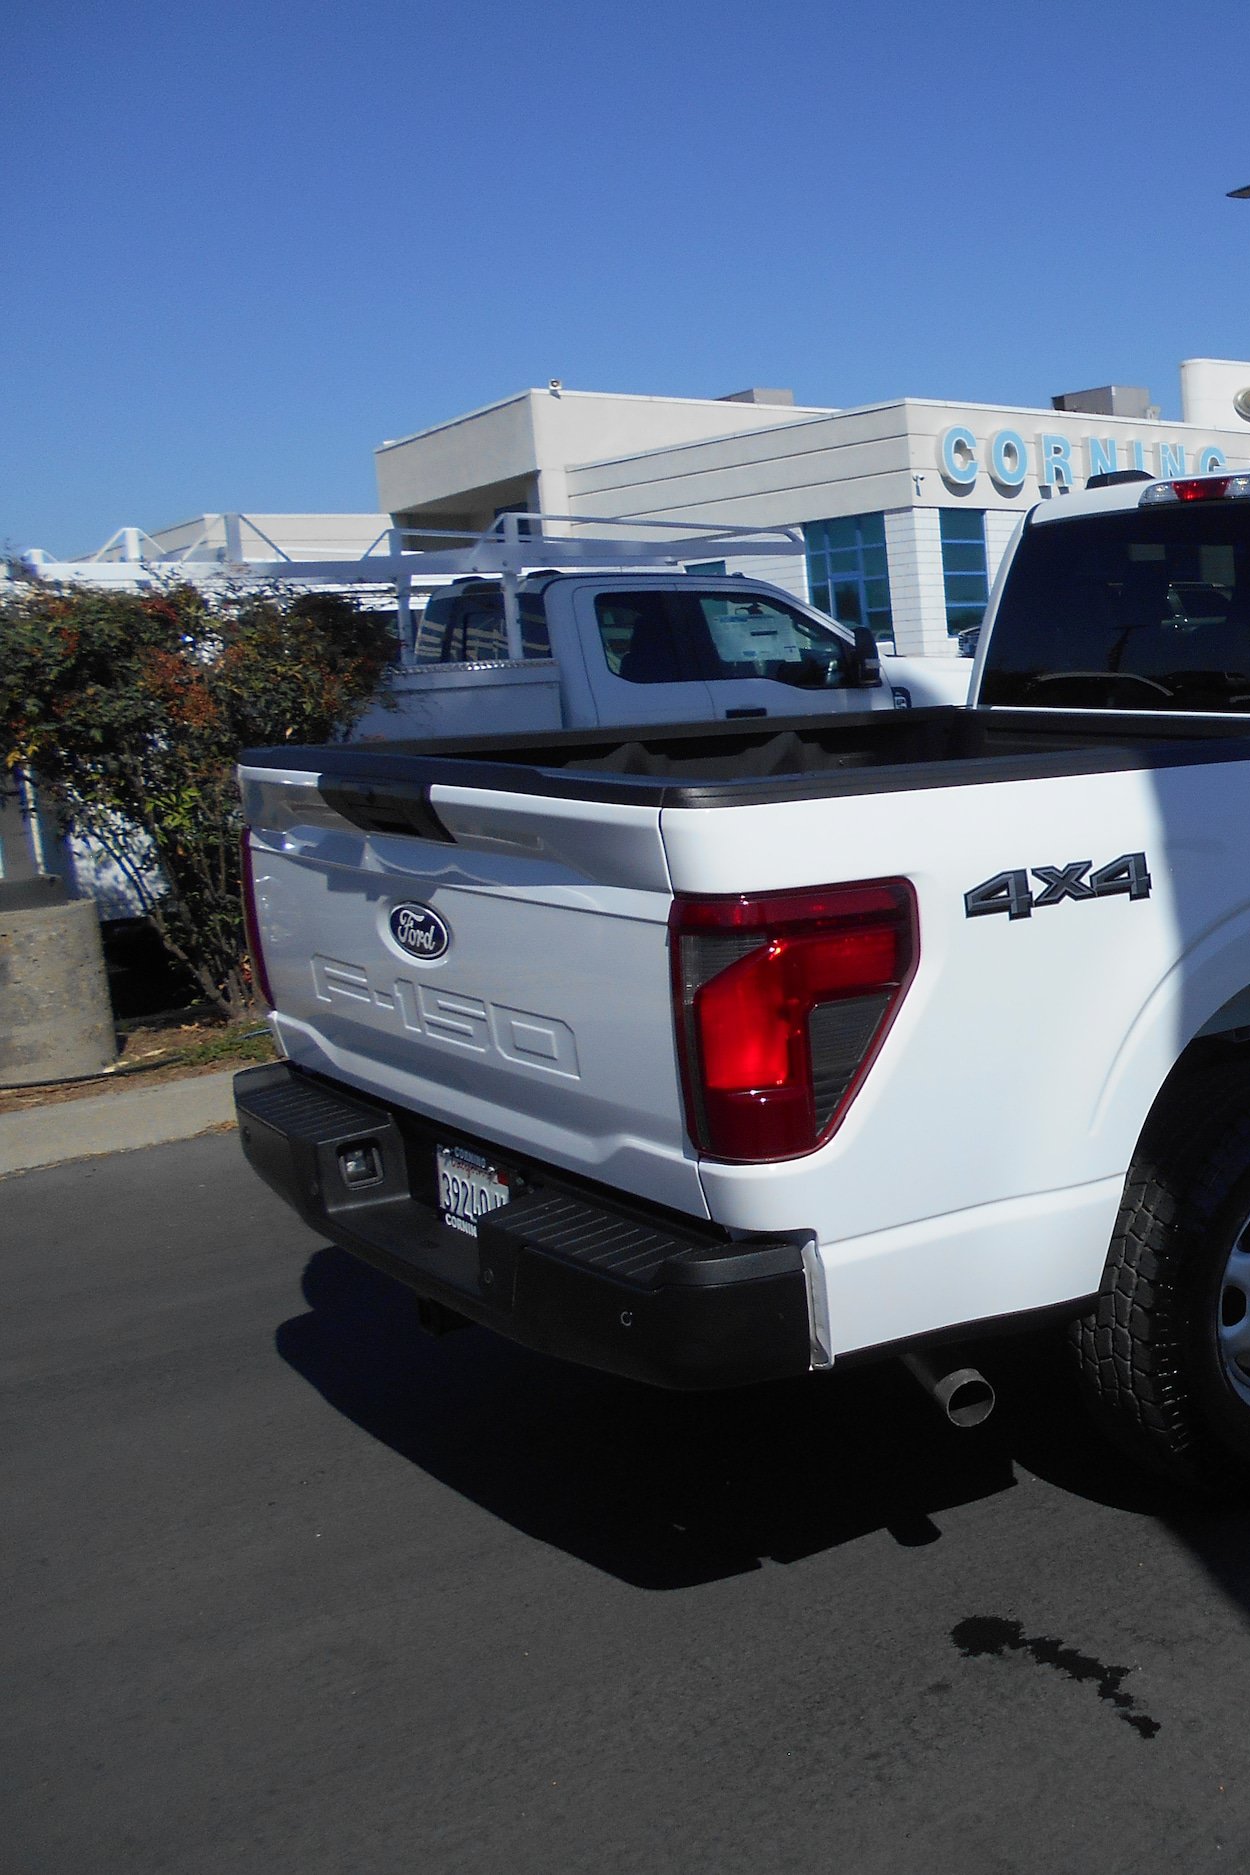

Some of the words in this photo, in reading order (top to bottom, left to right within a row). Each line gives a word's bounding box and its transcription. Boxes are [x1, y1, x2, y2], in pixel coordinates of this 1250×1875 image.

[938, 424, 1227, 486] CORNING
[397, 909, 436, 951] Ford
[310, 953, 581, 1080] F-150
[445, 1213, 478, 1238] CORNIN
